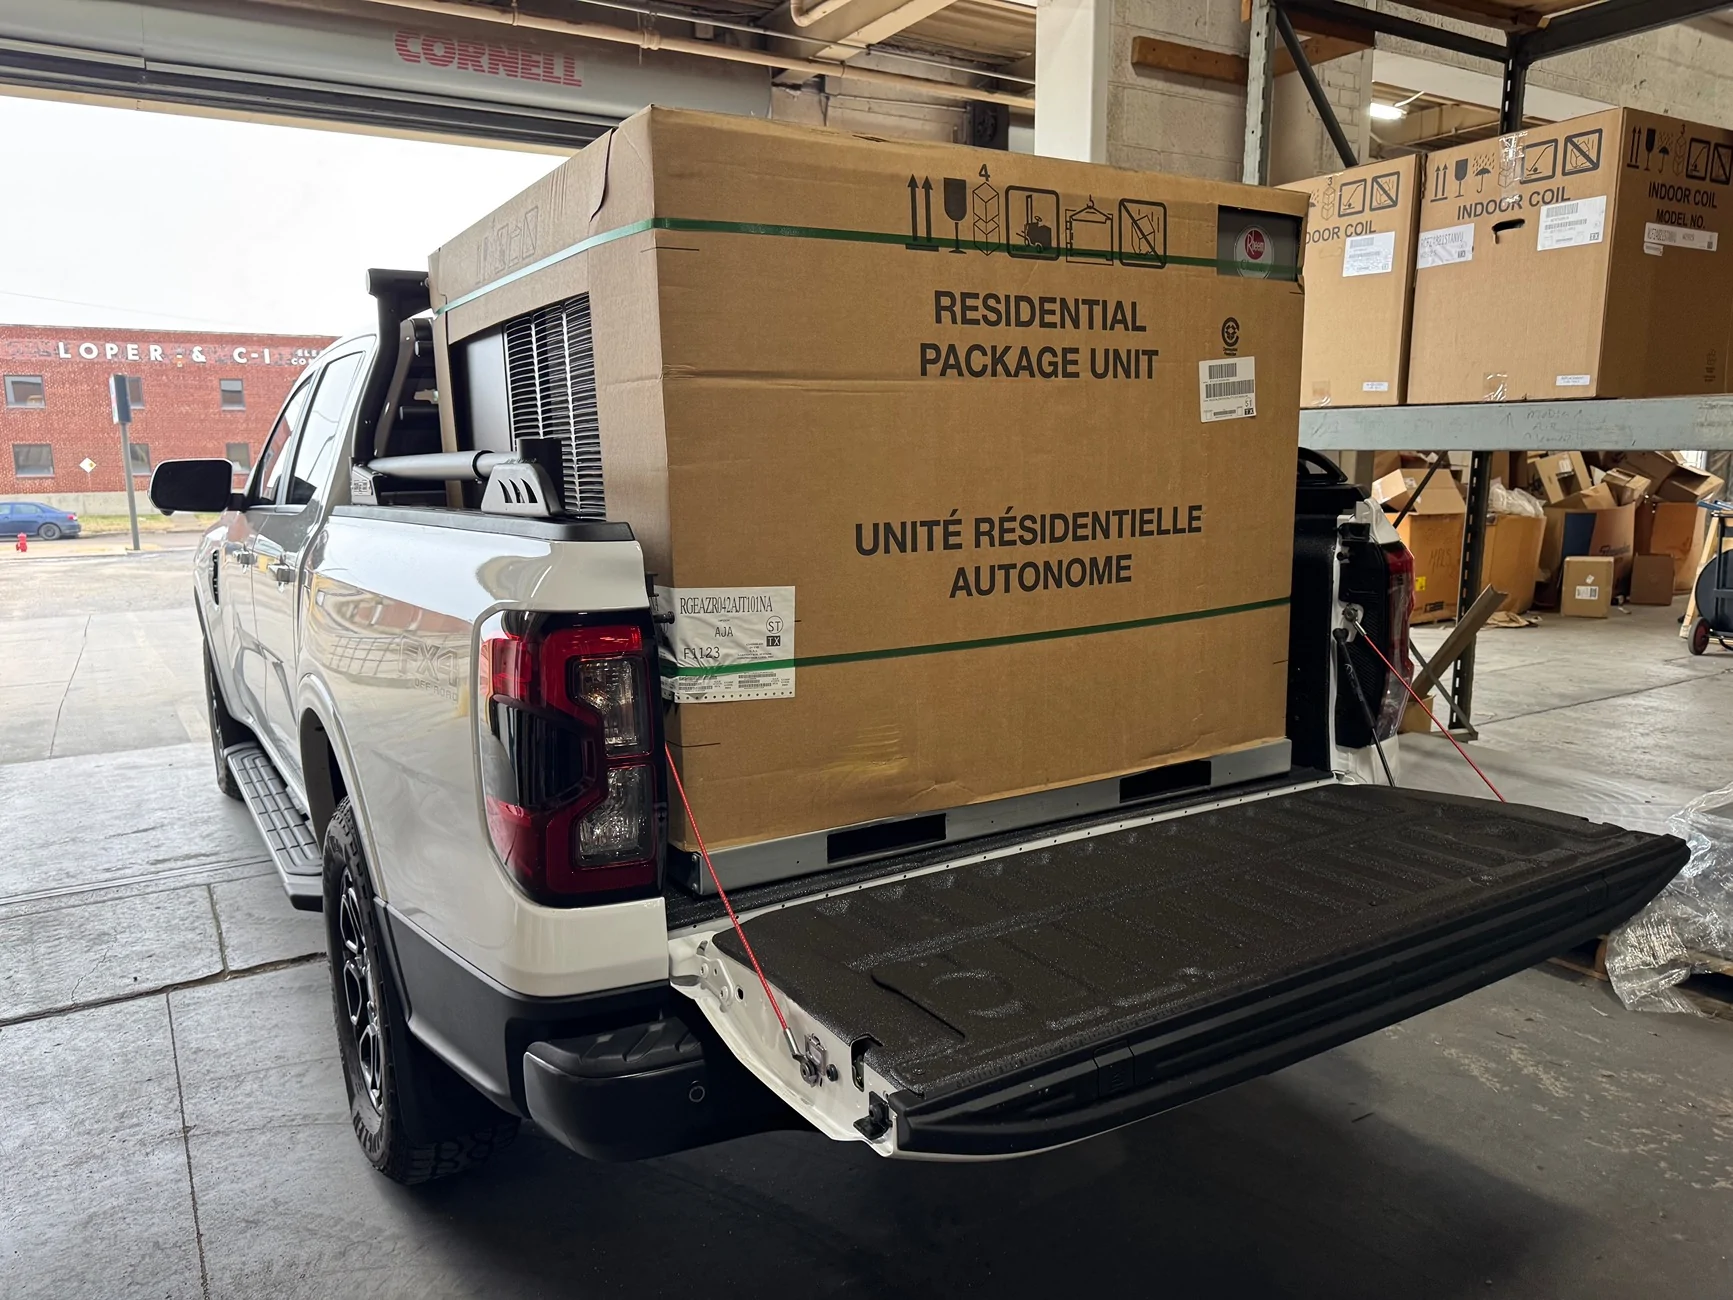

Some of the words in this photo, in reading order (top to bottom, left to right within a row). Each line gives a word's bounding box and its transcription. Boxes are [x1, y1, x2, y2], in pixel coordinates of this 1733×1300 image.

[394, 29, 582, 87] CORNELL
[978, 163, 991, 182] 4
[1457, 195, 1523, 220] INDOOR
[1529, 186, 1571, 207] COIL
[1649, 181, 1691, 205] INDOOR
[1693, 188, 1718, 208] COIL
[1344, 220, 1376, 237] COIL
[1655, 208, 1688, 226] MODEL
[1690, 213, 1706, 230] NO.
[934, 290, 1146, 332] RESIDENTIAL
[58, 341, 164, 362] LOPER
[191, 346, 207, 363] &
[920, 343, 1080, 378] PACKAGE
[1090, 348, 1159, 380] UNIT
[855, 508, 963, 556] UNITÉ
[974, 504, 1203, 549] RÉSIDENTIELLE
[949, 554, 1133, 598] AUTONOME
[714, 626, 734, 638] AJA
[768, 620, 781, 633] ST
[767, 637, 780, 646] TX
[683, 647, 721, 660] F1123
